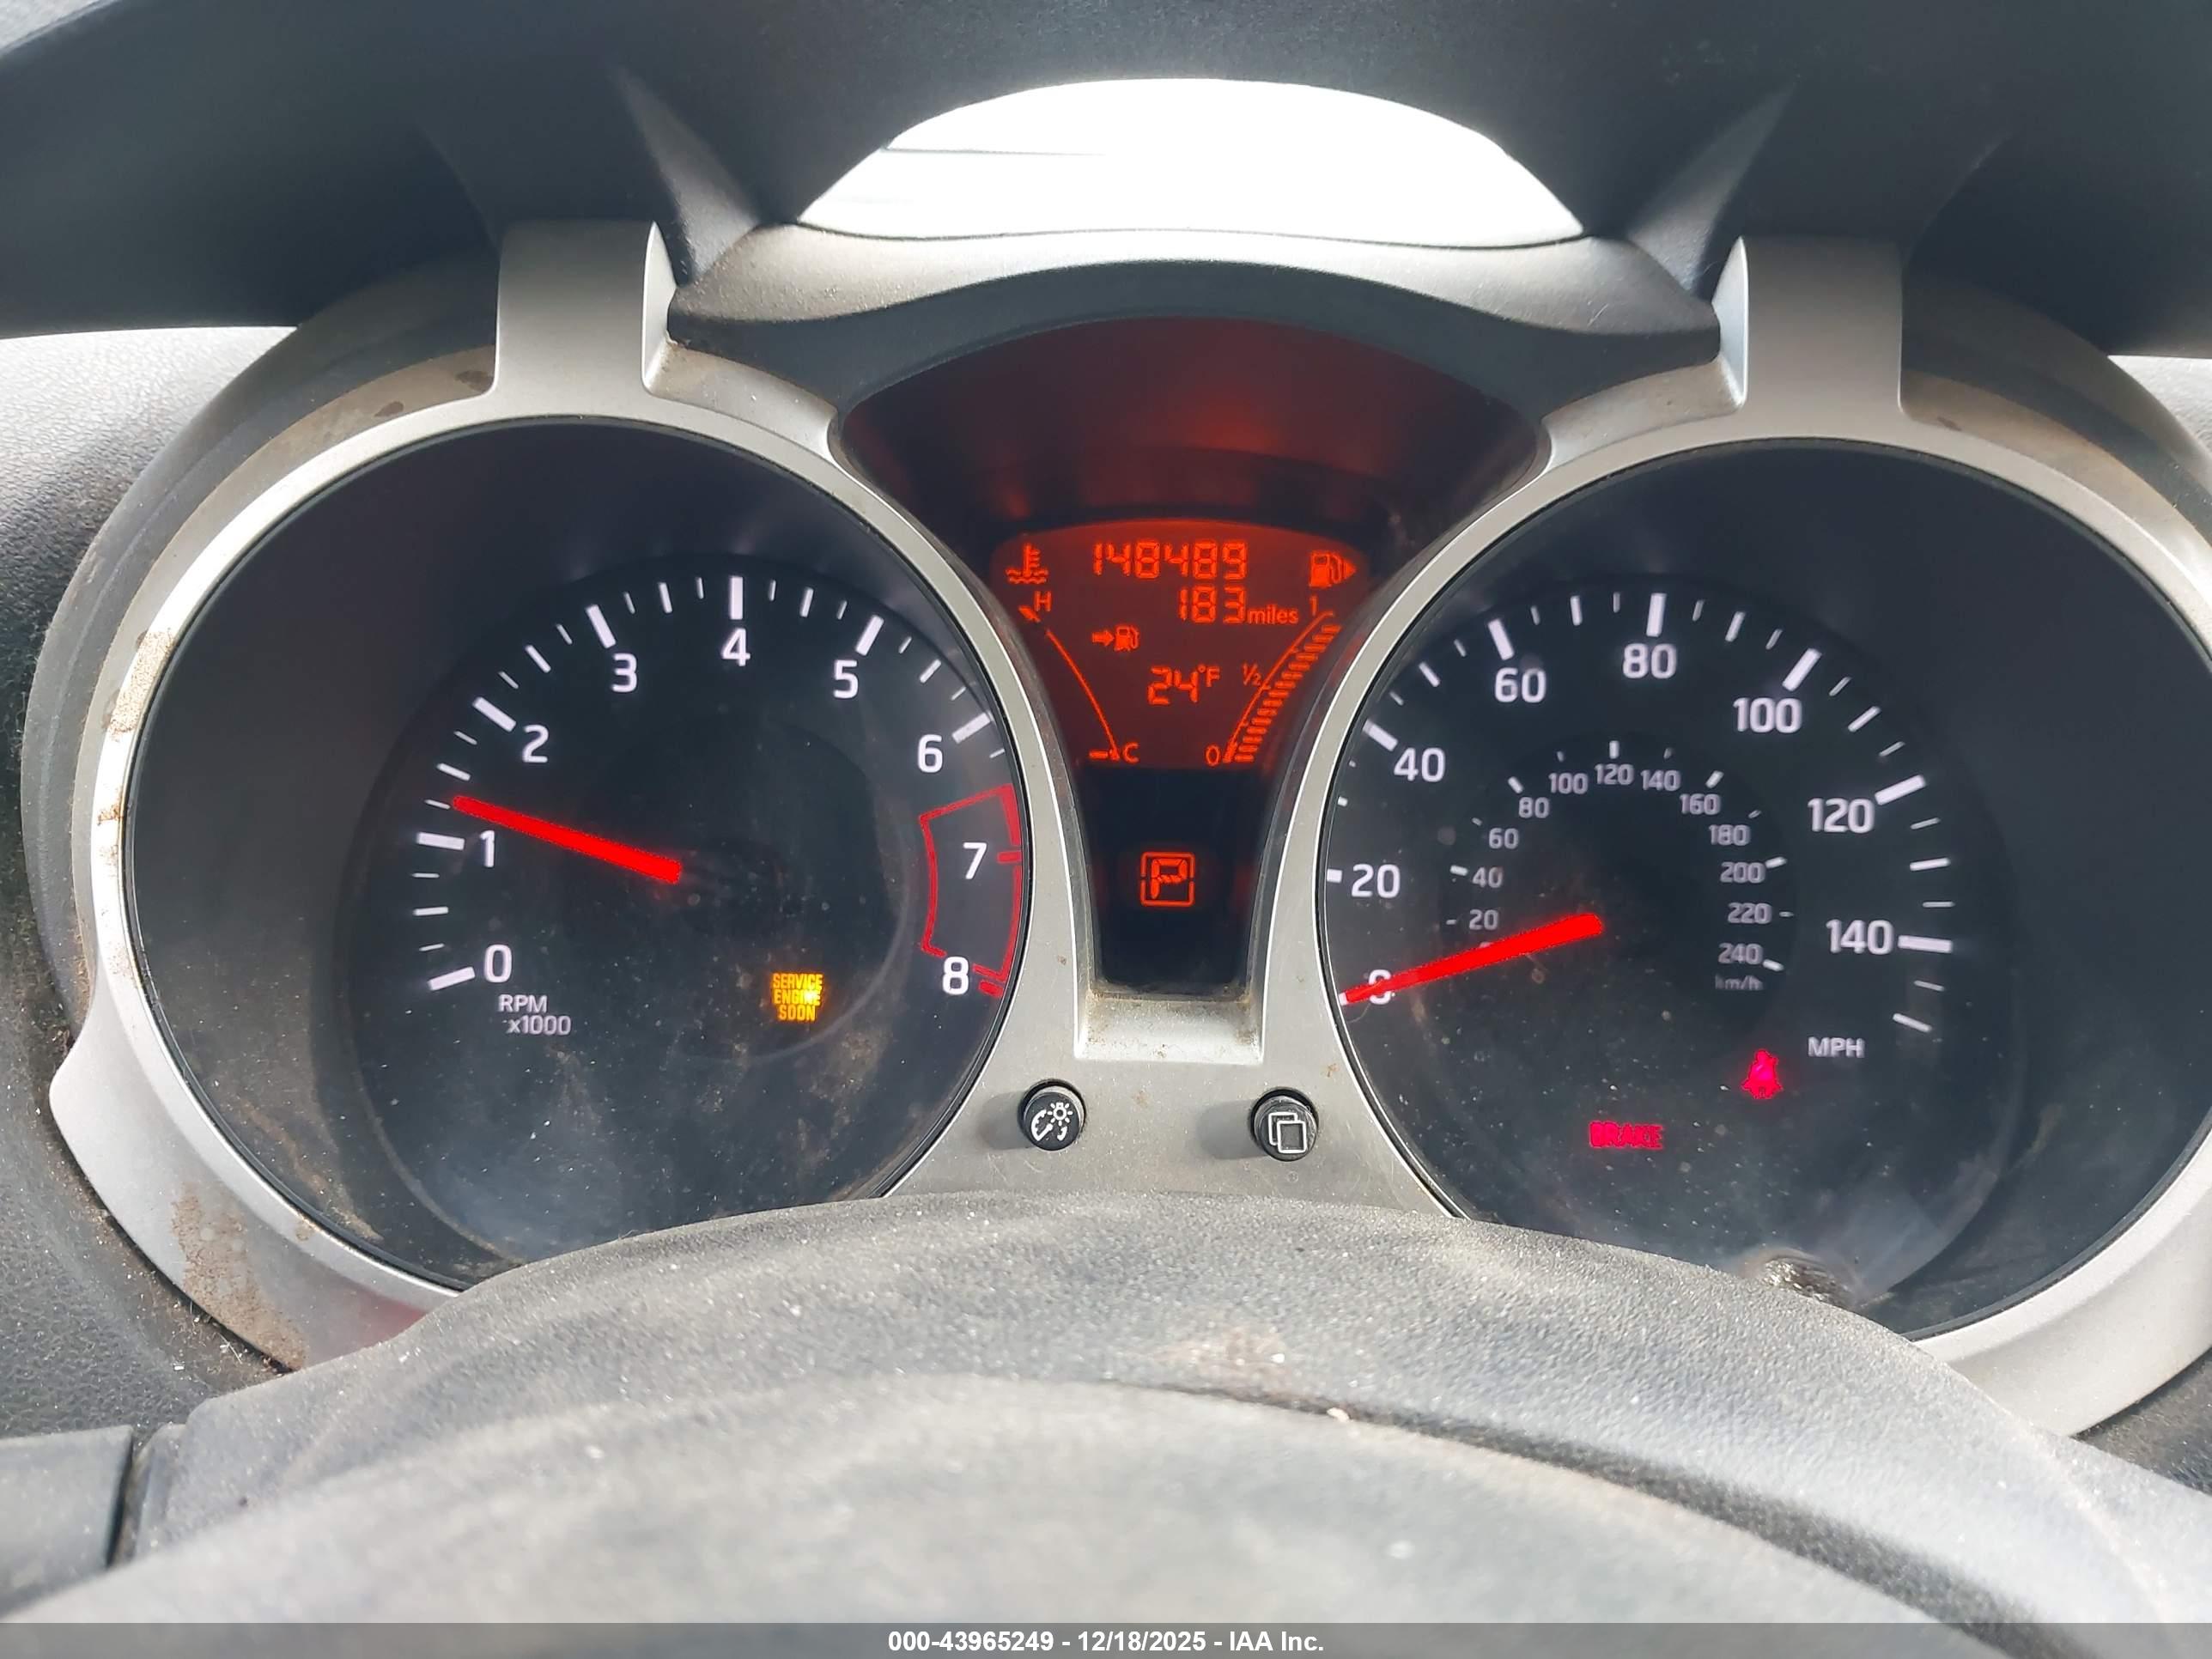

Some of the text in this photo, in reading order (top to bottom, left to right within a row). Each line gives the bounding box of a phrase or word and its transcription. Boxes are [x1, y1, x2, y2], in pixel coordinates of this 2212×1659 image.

[1093, 539, 1249, 580] 148489
[1034, 591, 1052, 612] H
[1179, 585, 1299, 625] 183 miles
[721, 628, 751, 667] 4
[1622, 642, 1677, 679] 80
[611, 653, 638, 693] 3
[833, 659, 859, 699] 5
[1494, 667, 1547, 703] 60
[1733, 697, 1802, 734] 100
[522, 724, 549, 763] 2
[917, 733, 944, 773] 6
[1122, 742, 1139, 763] C
[1394, 747, 1446, 783] 40
[1595, 763, 1634, 786] 120
[1548, 772, 1589, 794] 100
[1640, 769, 1681, 792] 140
[1518, 796, 1550, 818] 80
[1679, 793, 1721, 816] 160
[1808, 798, 1875, 834] 120
[479, 830, 495, 867] 1
[1488, 827, 1519, 849] 60
[1708, 823, 1750, 846] 180
[963, 842, 988, 880] 7
[1720, 861, 1765, 884] 200
[1152, 859, 1188, 899] P
[1351, 863, 1401, 898] 20
[1472, 866, 1504, 889] 40
[1468, 908, 1499, 931] 20
[1727, 902, 1772, 925] 220
[1826, 919, 1893, 955] 140
[483, 944, 513, 983] 0
[1718, 942, 1764, 964] 240
[773, 973, 823, 990] SERVICE
[942, 956, 970, 995] 8
[498, 994, 548, 1014] RPM
[774, 989, 821, 1006] ENGINE
[779, 1004, 816, 1022] SOON
[1808, 1036, 1865, 1058] MPH
[1589, 1121, 1663, 1150] BRAKE
